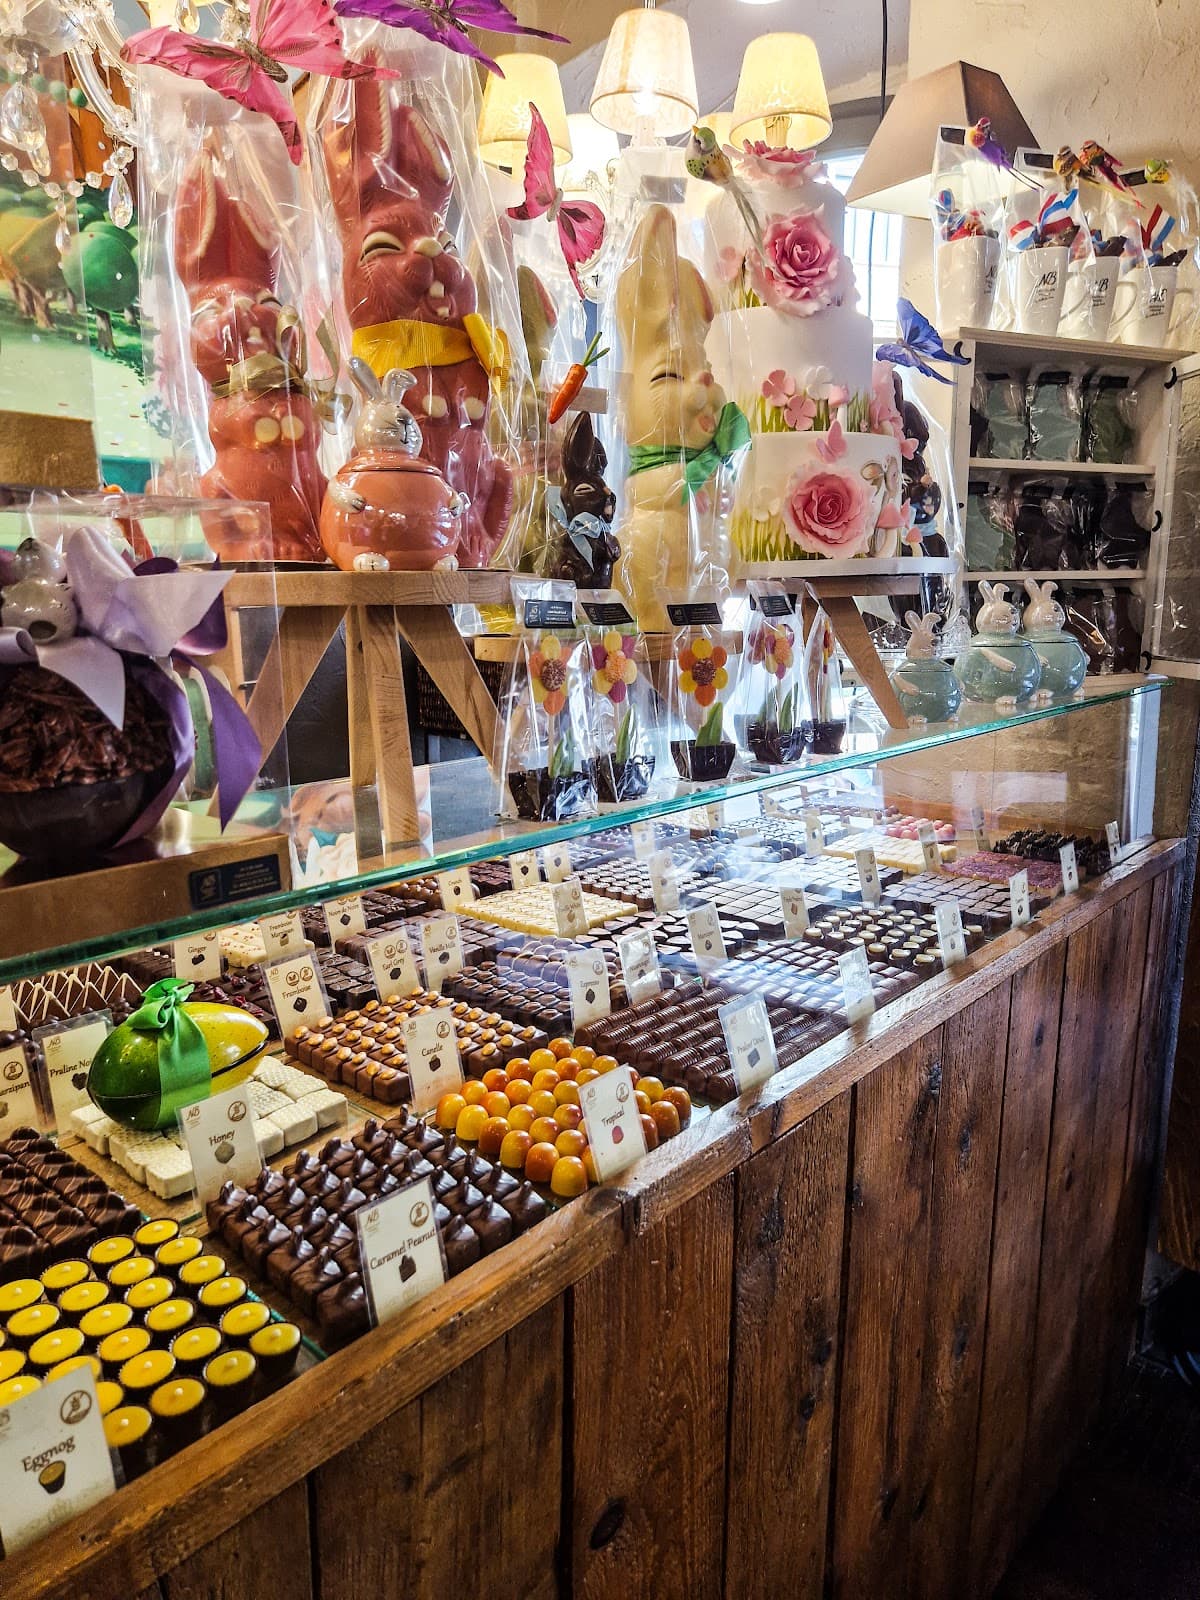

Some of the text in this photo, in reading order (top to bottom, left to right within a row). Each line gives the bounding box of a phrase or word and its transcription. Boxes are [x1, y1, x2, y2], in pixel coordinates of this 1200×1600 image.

[282, 984, 312, 1000] Framboise
[49, 1063, 78, 1079] Praline
[601, 1105, 625, 1127] Tropical
[208, 1129, 236, 1147] Honey
[370, 1227, 436, 1270] Caramel Peanut
[22, 1436, 76, 1473] Eggnog
